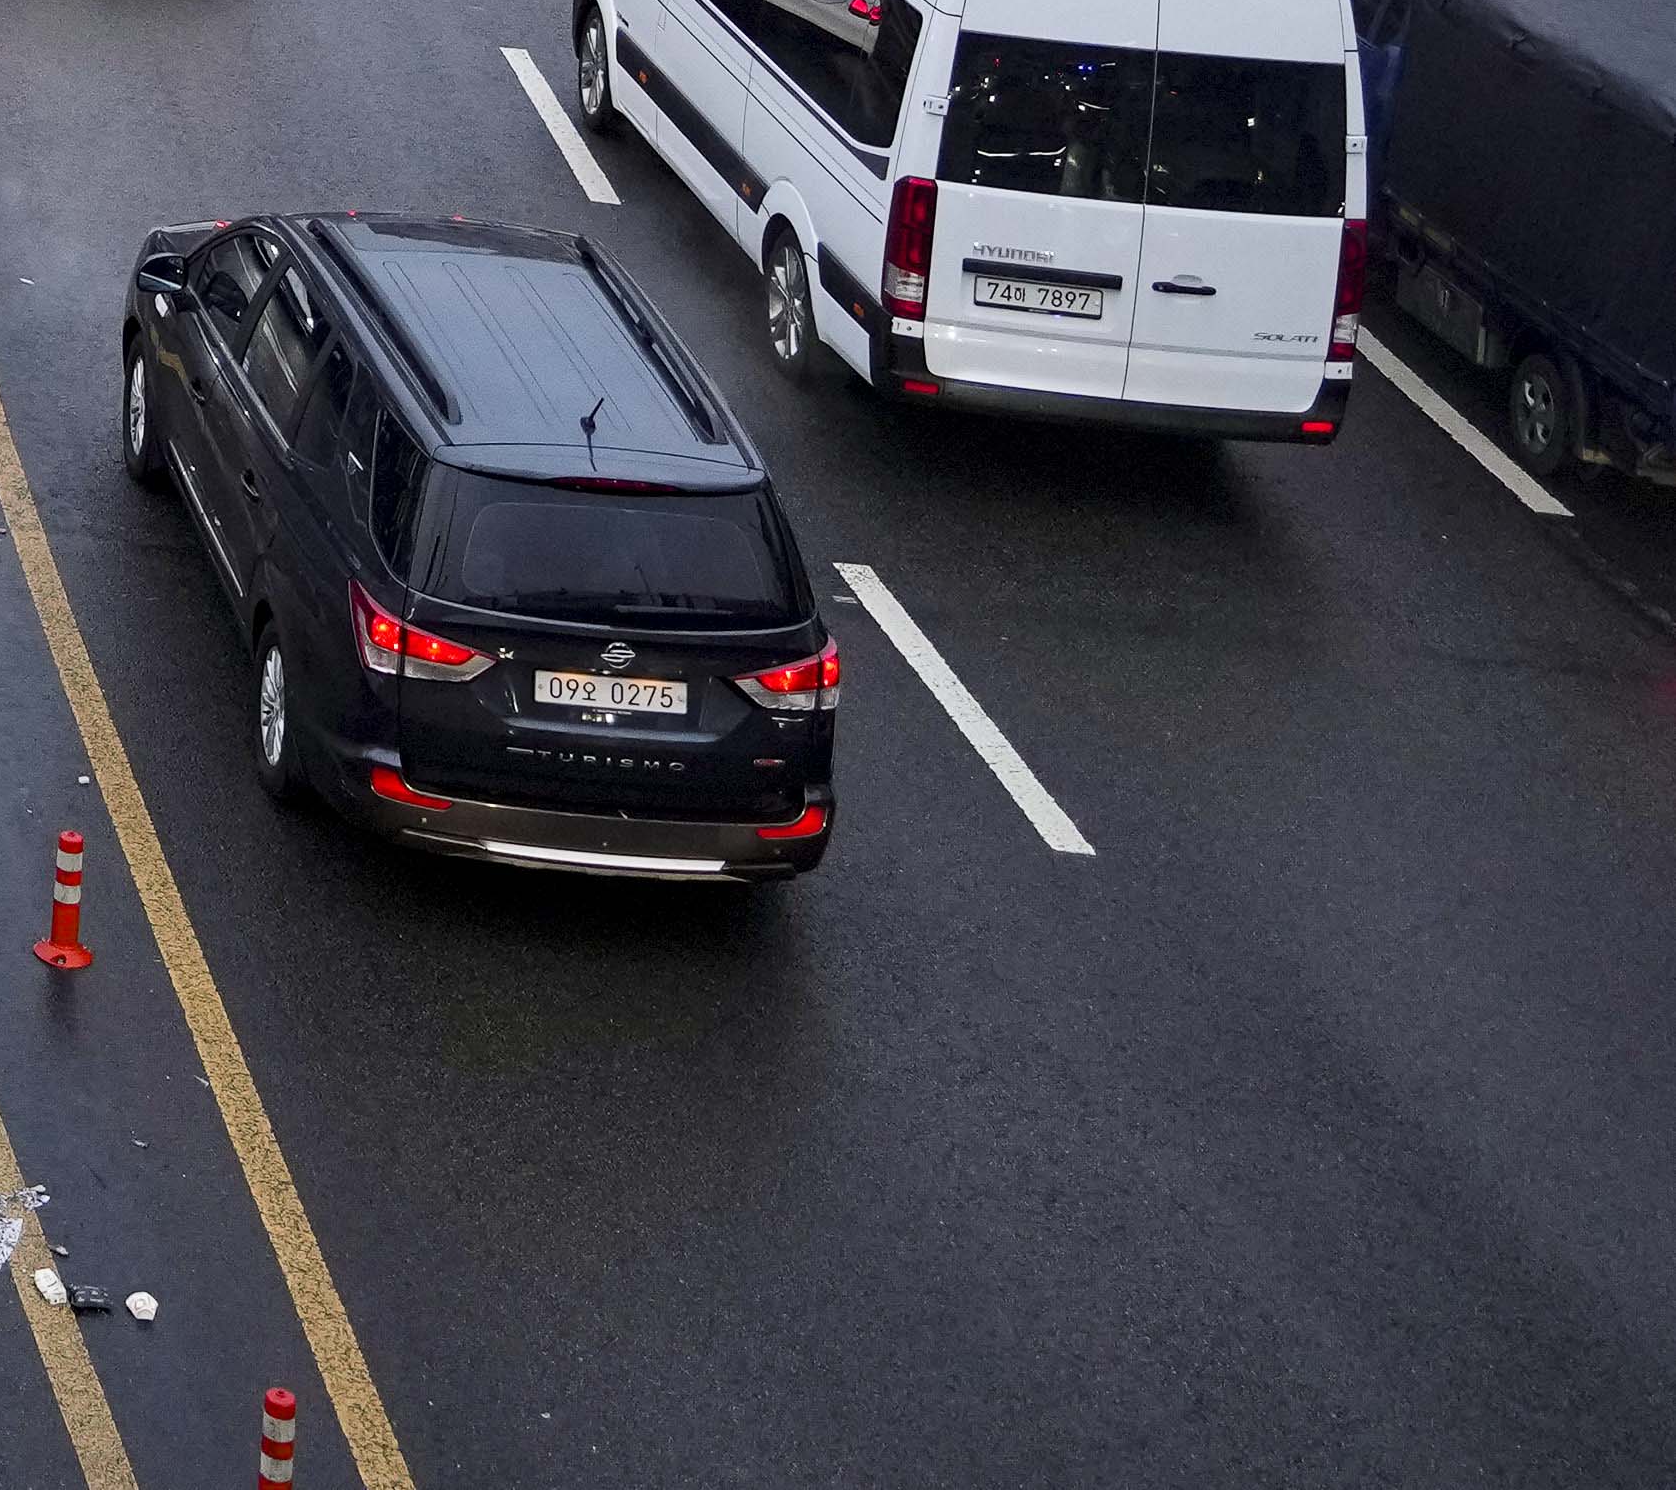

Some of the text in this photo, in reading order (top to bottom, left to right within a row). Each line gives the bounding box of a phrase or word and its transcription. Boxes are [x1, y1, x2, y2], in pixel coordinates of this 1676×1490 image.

[973, 244, 1055, 266] HYUNDAI
[986, 282, 1094, 315] 74아 7897
[1253, 331, 1320, 347] SOLATI
[548, 677, 673, 708] 09오 0275
[538, 748, 685, 772] TURISMO
